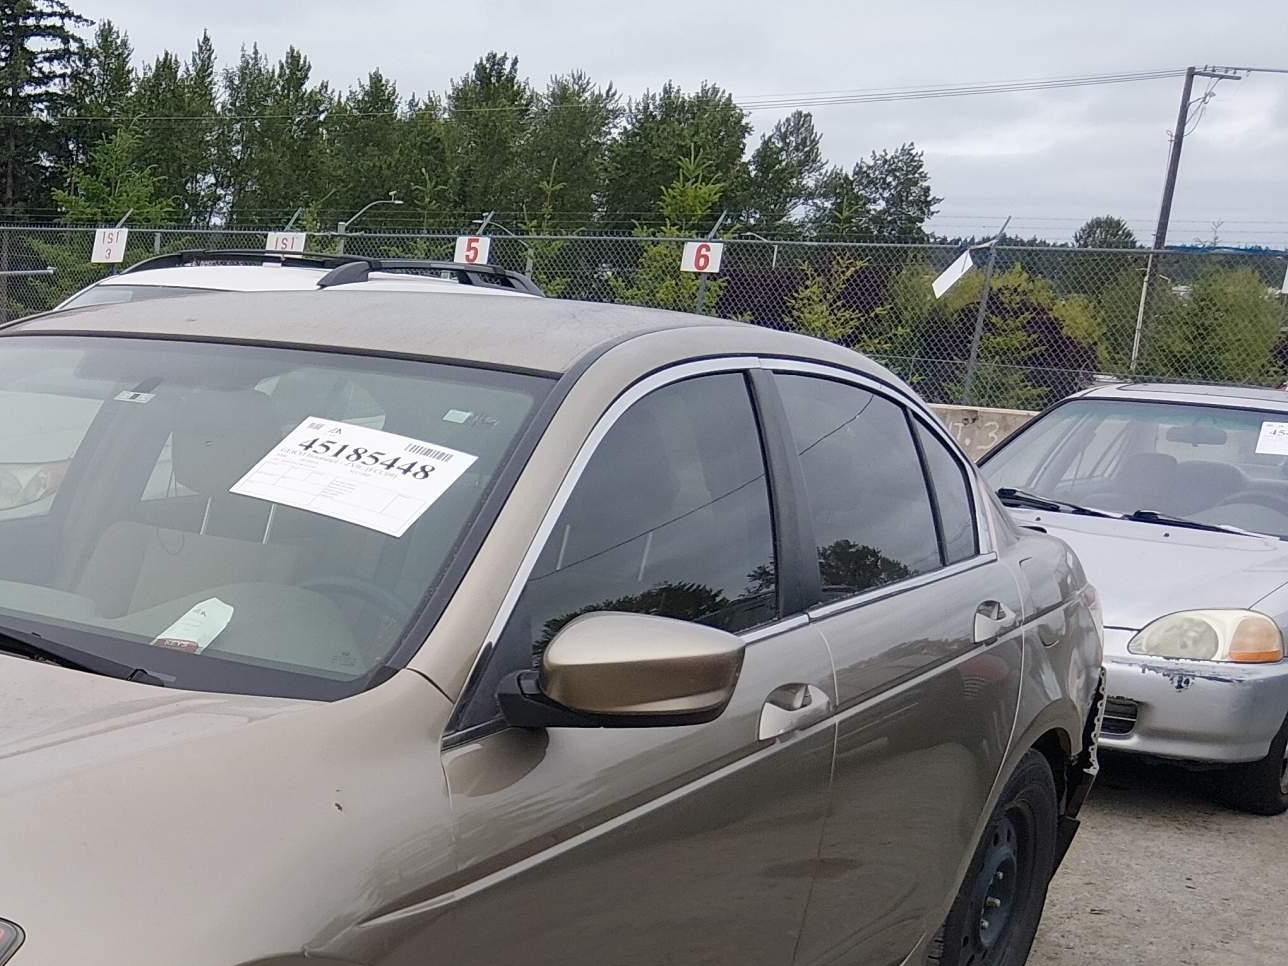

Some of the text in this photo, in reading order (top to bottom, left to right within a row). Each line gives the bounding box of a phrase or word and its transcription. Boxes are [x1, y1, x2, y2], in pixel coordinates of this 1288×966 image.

[105, 248, 112, 260] 3
[465, 237, 480, 263] 5
[693, 243, 711, 271] 6
[298, 437, 436, 480] 45185448
